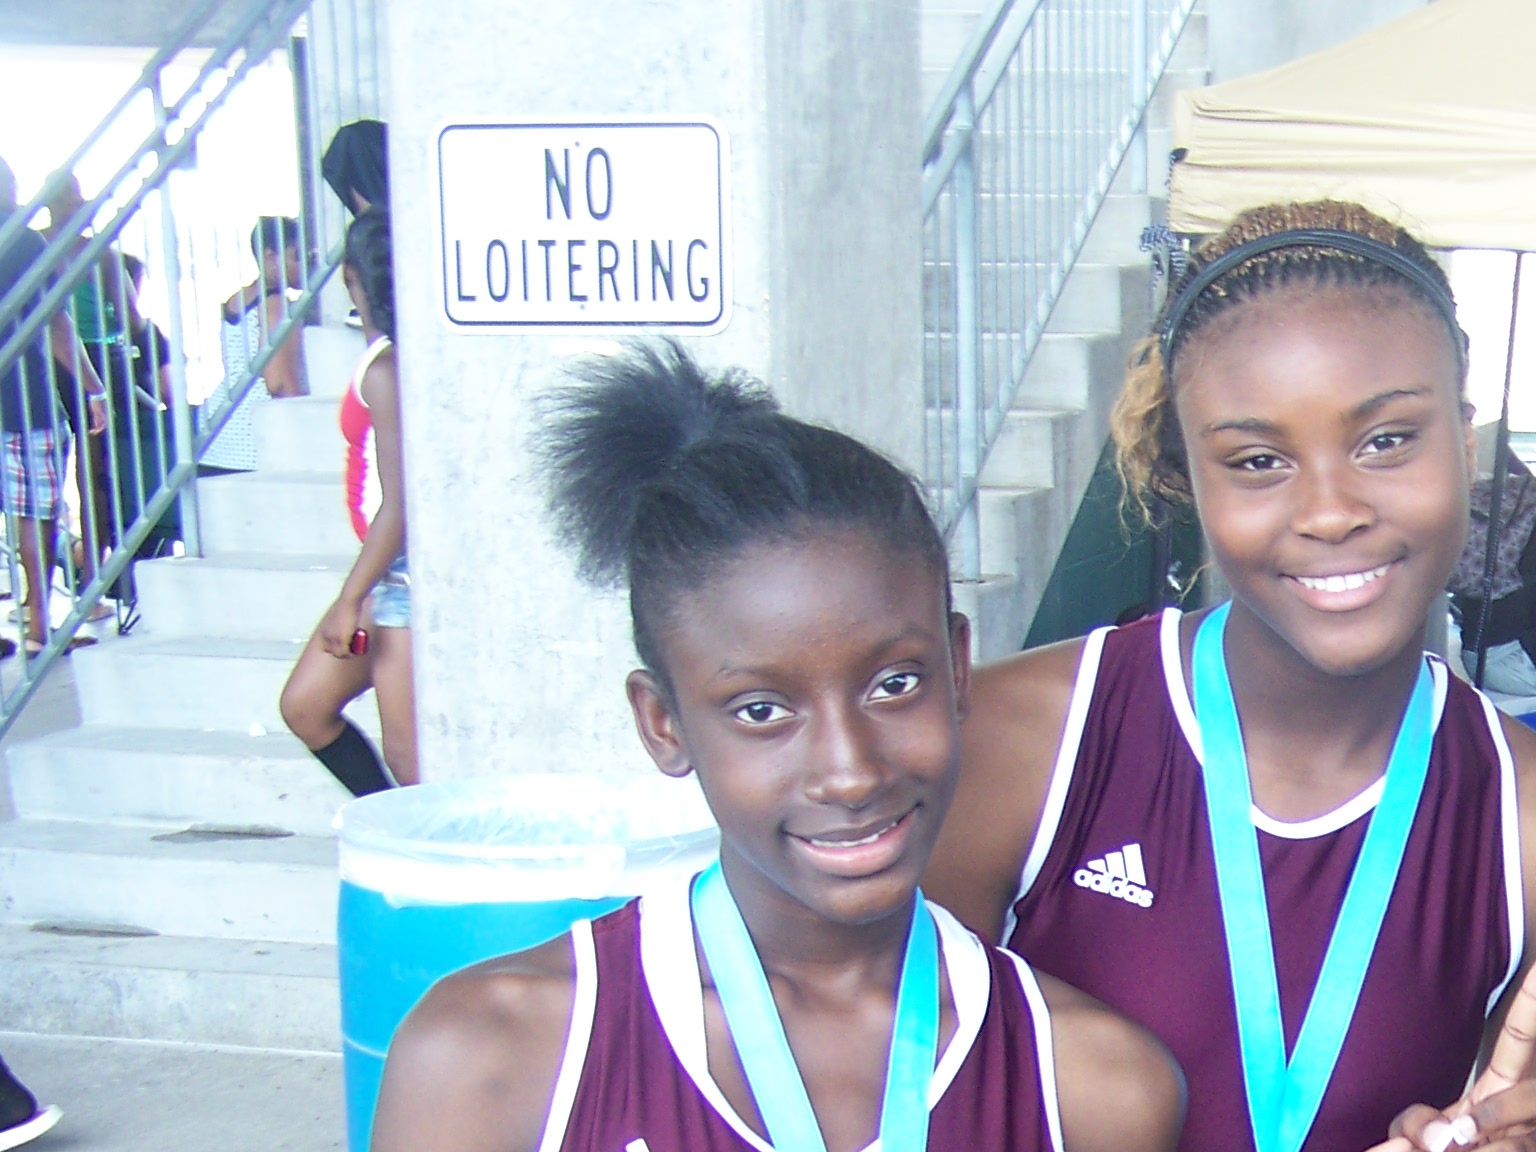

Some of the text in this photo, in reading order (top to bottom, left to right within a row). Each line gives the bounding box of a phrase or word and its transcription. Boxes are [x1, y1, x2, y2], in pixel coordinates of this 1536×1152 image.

[544, 147, 613, 221] NO
[455, 238, 709, 302] LOITERING
[1074, 868, 1154, 908] adidas
